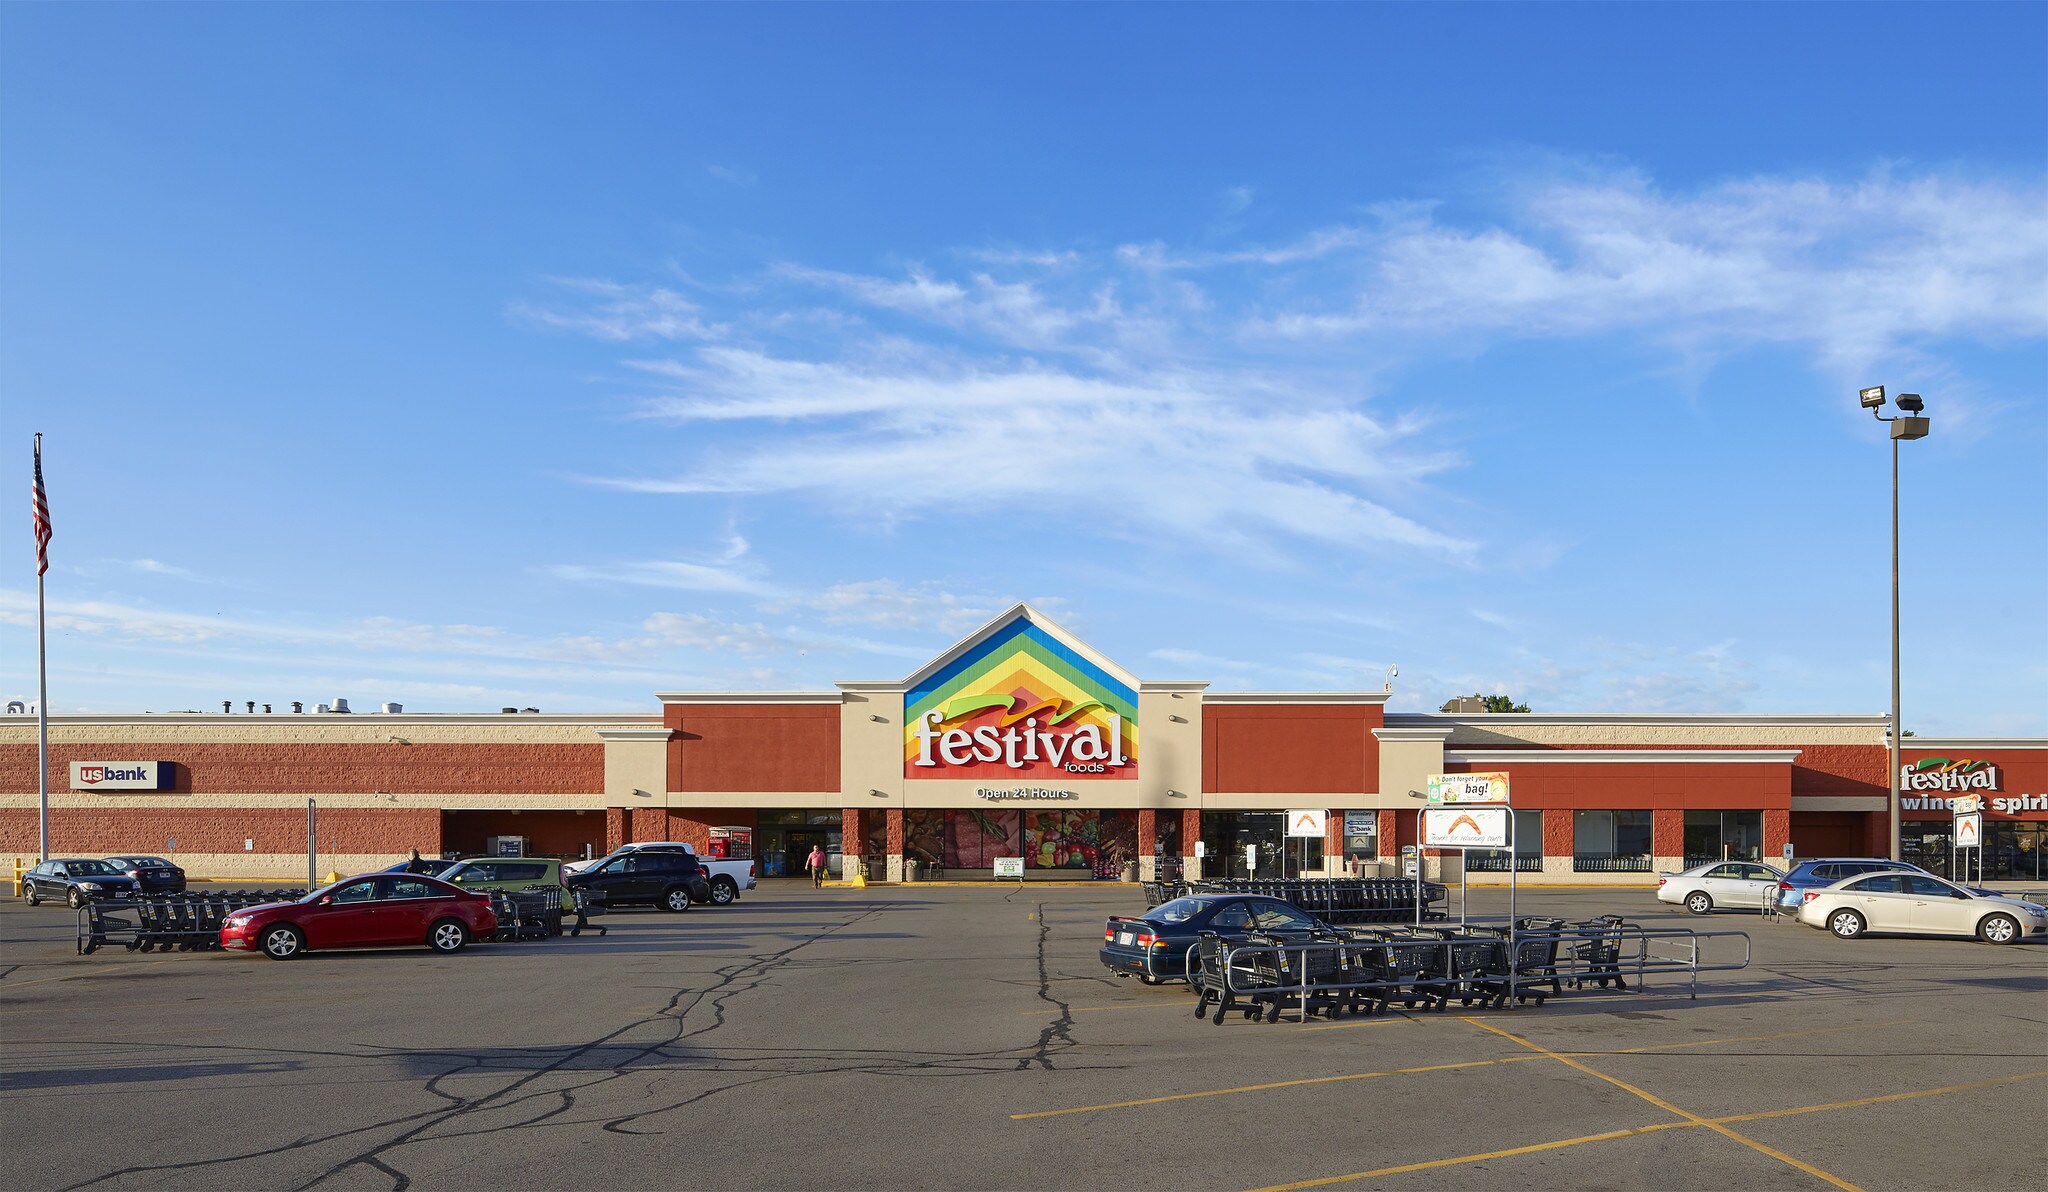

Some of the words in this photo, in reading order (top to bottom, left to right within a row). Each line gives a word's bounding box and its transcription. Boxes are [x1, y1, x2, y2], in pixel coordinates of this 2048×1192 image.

[913, 710, 1123, 768] festival
[1064, 762, 1105, 773] foods
[1900, 764, 1998, 792] festival
[975, 788, 1009, 800] Open
[1012, 788, 1028, 798] 24
[1031, 788, 1069, 798] Hours
[1465, 783, 1489, 796] bag!
